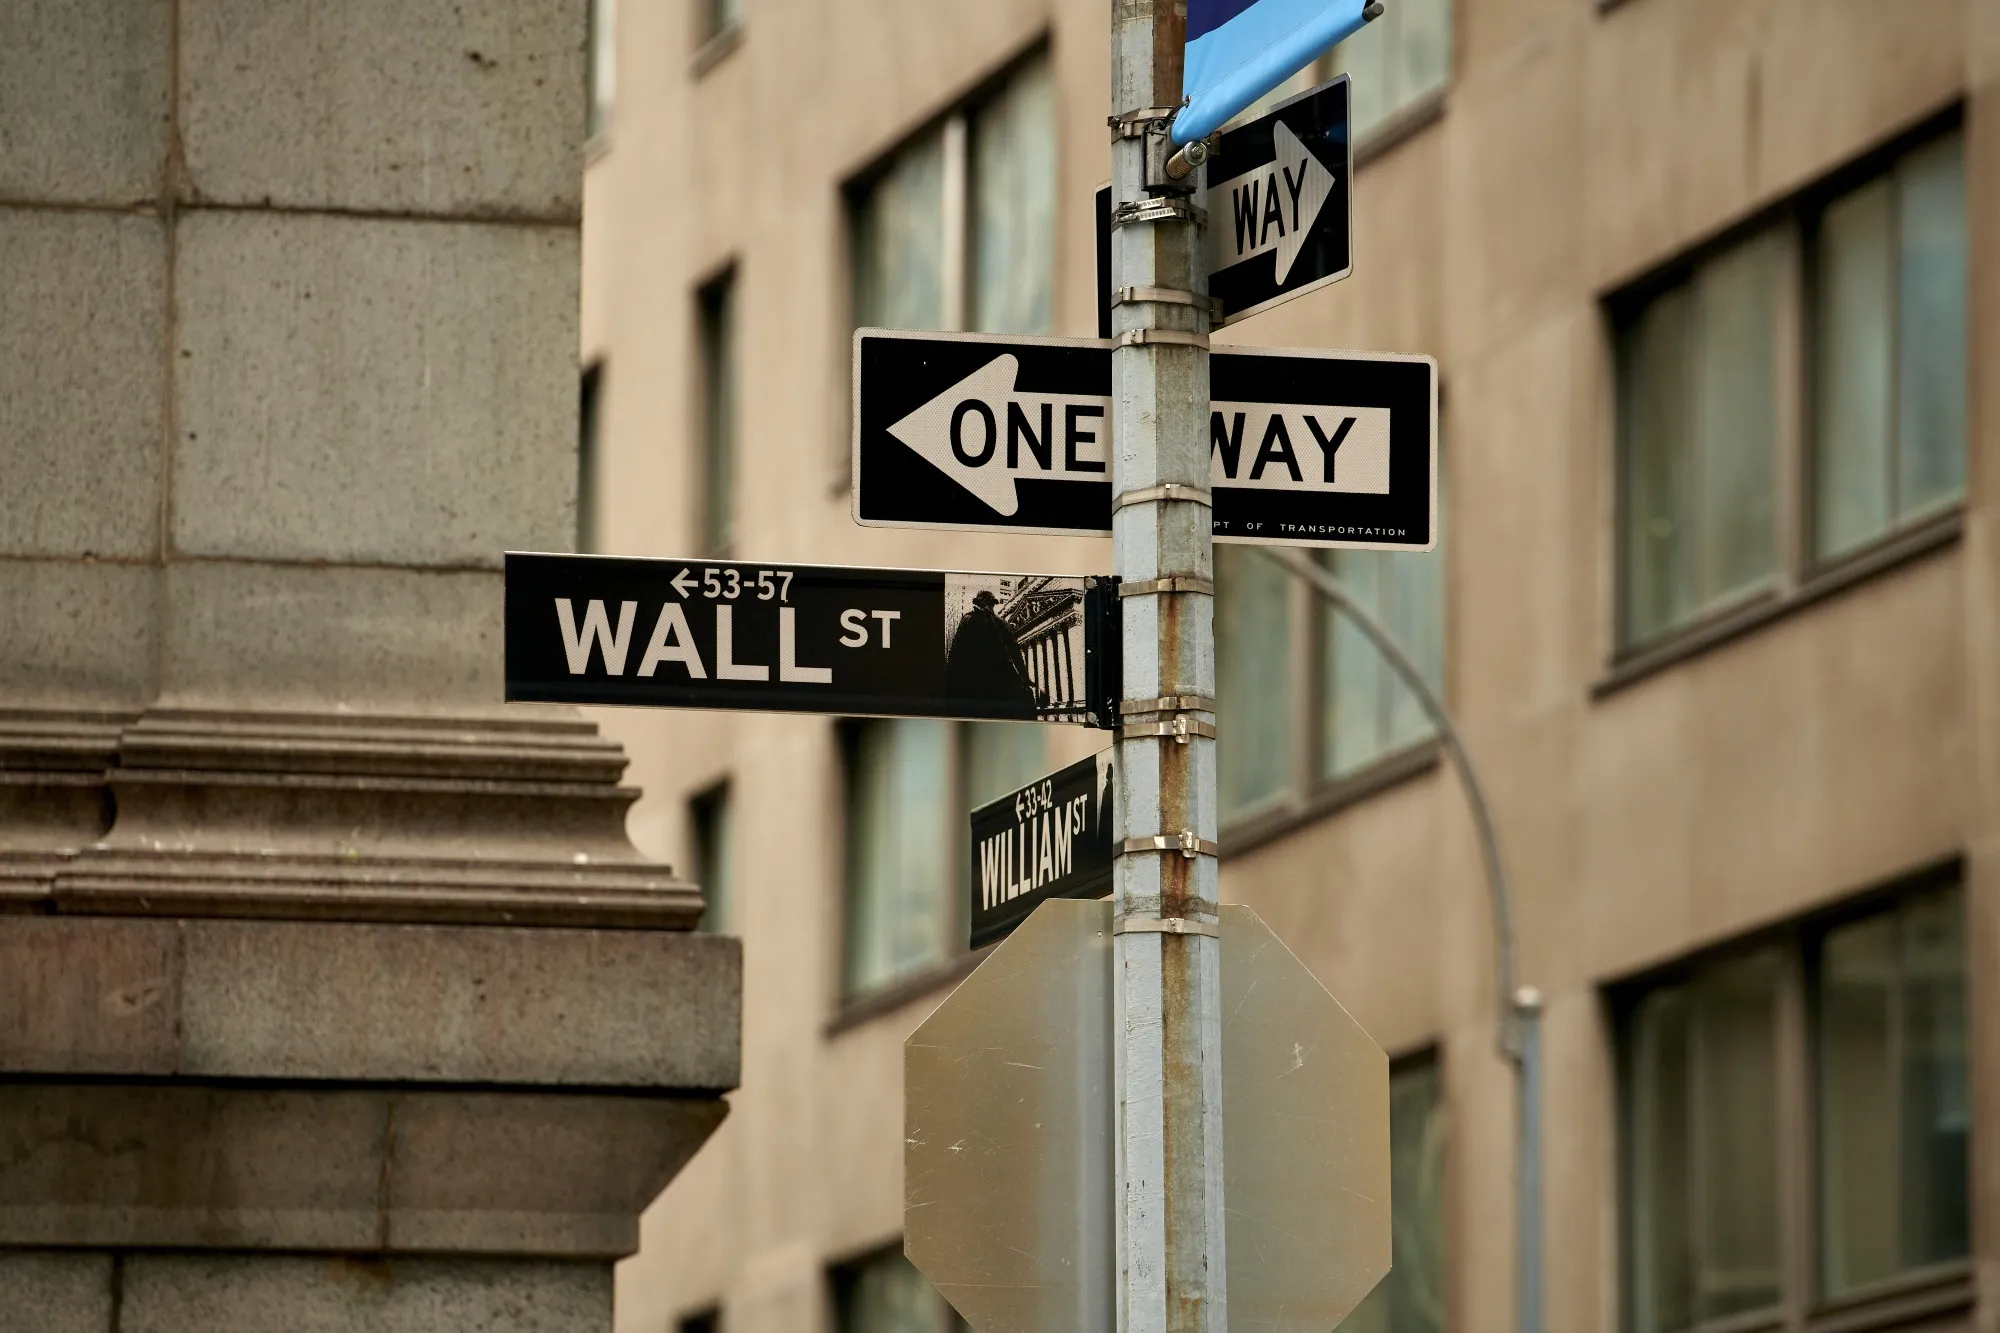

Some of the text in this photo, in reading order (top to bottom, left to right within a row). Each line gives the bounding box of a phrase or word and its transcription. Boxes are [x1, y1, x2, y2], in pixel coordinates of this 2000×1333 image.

[1232, 158, 1309, 256] WAY
[949, 398, 1356, 483] ONE WAY
[1246, 522, 1264, 531] OF
[1280, 523, 1406, 536] TRANSPORTATION
[702, 568, 794, 602] 53-57
[554, 597, 901, 684] WALL ST
[1025, 779, 1053, 819] 33-42
[980, 793, 1088, 911] WILLIAM ST
